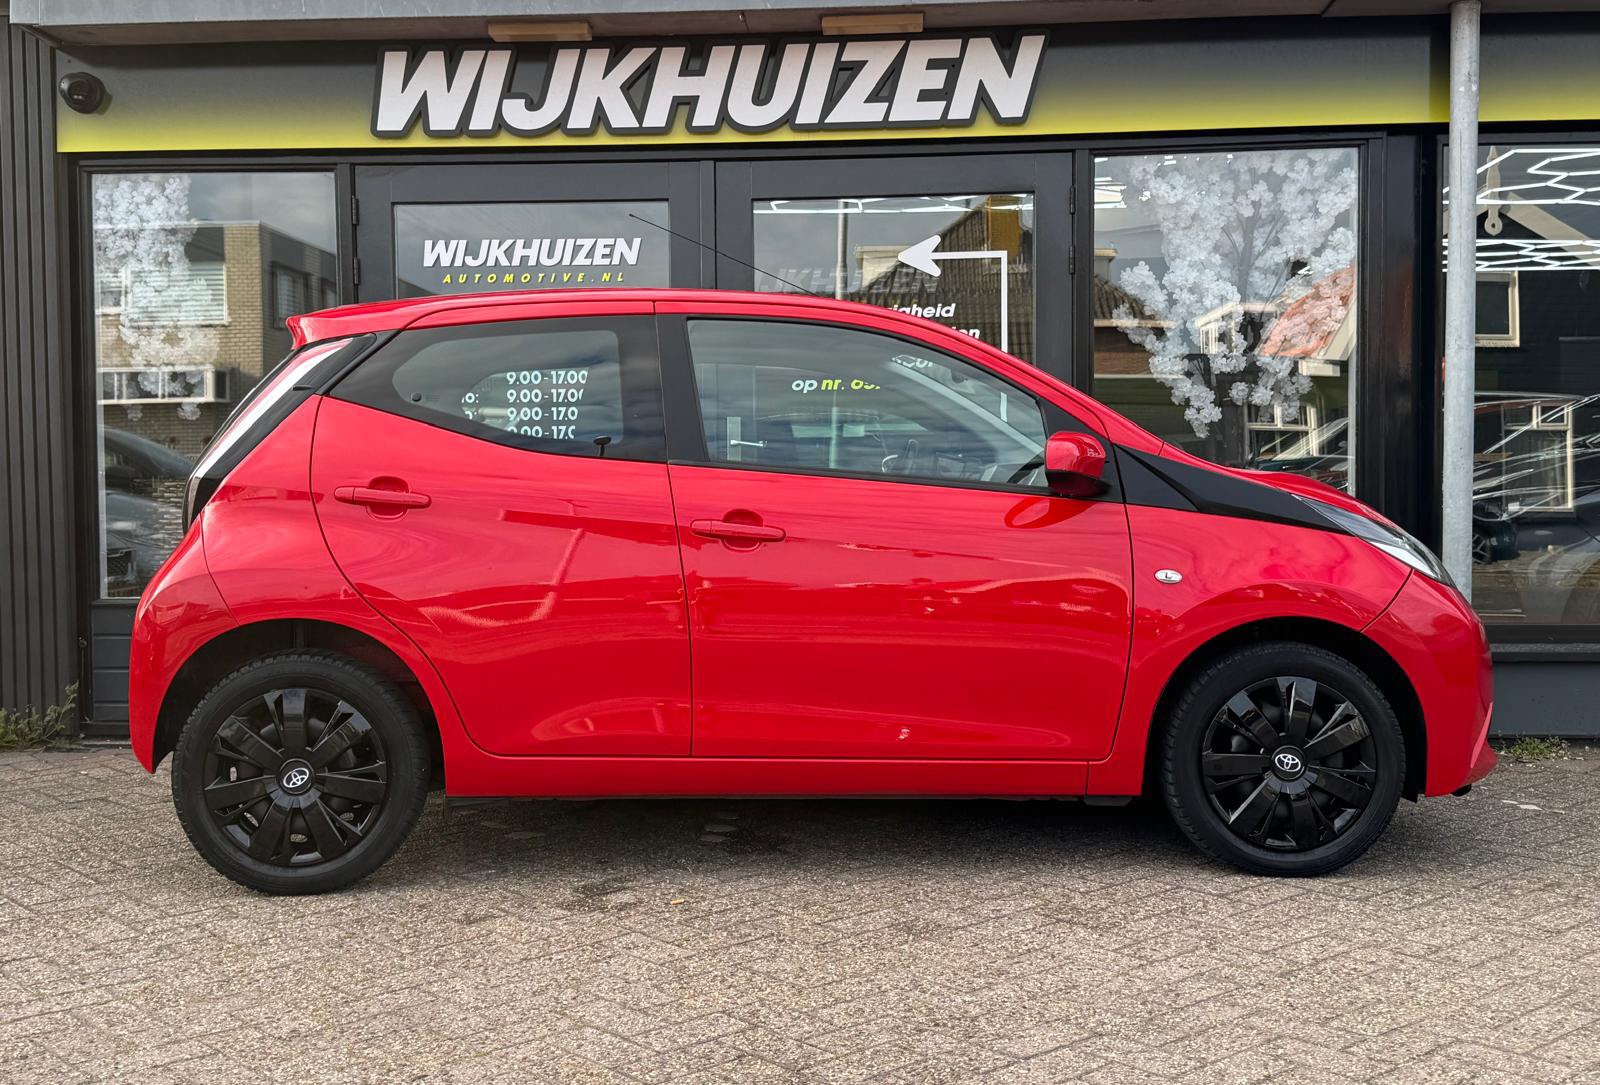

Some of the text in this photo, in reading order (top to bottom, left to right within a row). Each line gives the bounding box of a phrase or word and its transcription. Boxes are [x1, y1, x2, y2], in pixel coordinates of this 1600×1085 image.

[374, 33, 1047, 134] WIJKHUIZEN
[423, 238, 642, 267] WIJKHUIZEN
[442, 272, 624, 284] AUTOMOTIVE.NL
[791, 379, 818, 394] op
[821, 378, 845, 390] nr.
